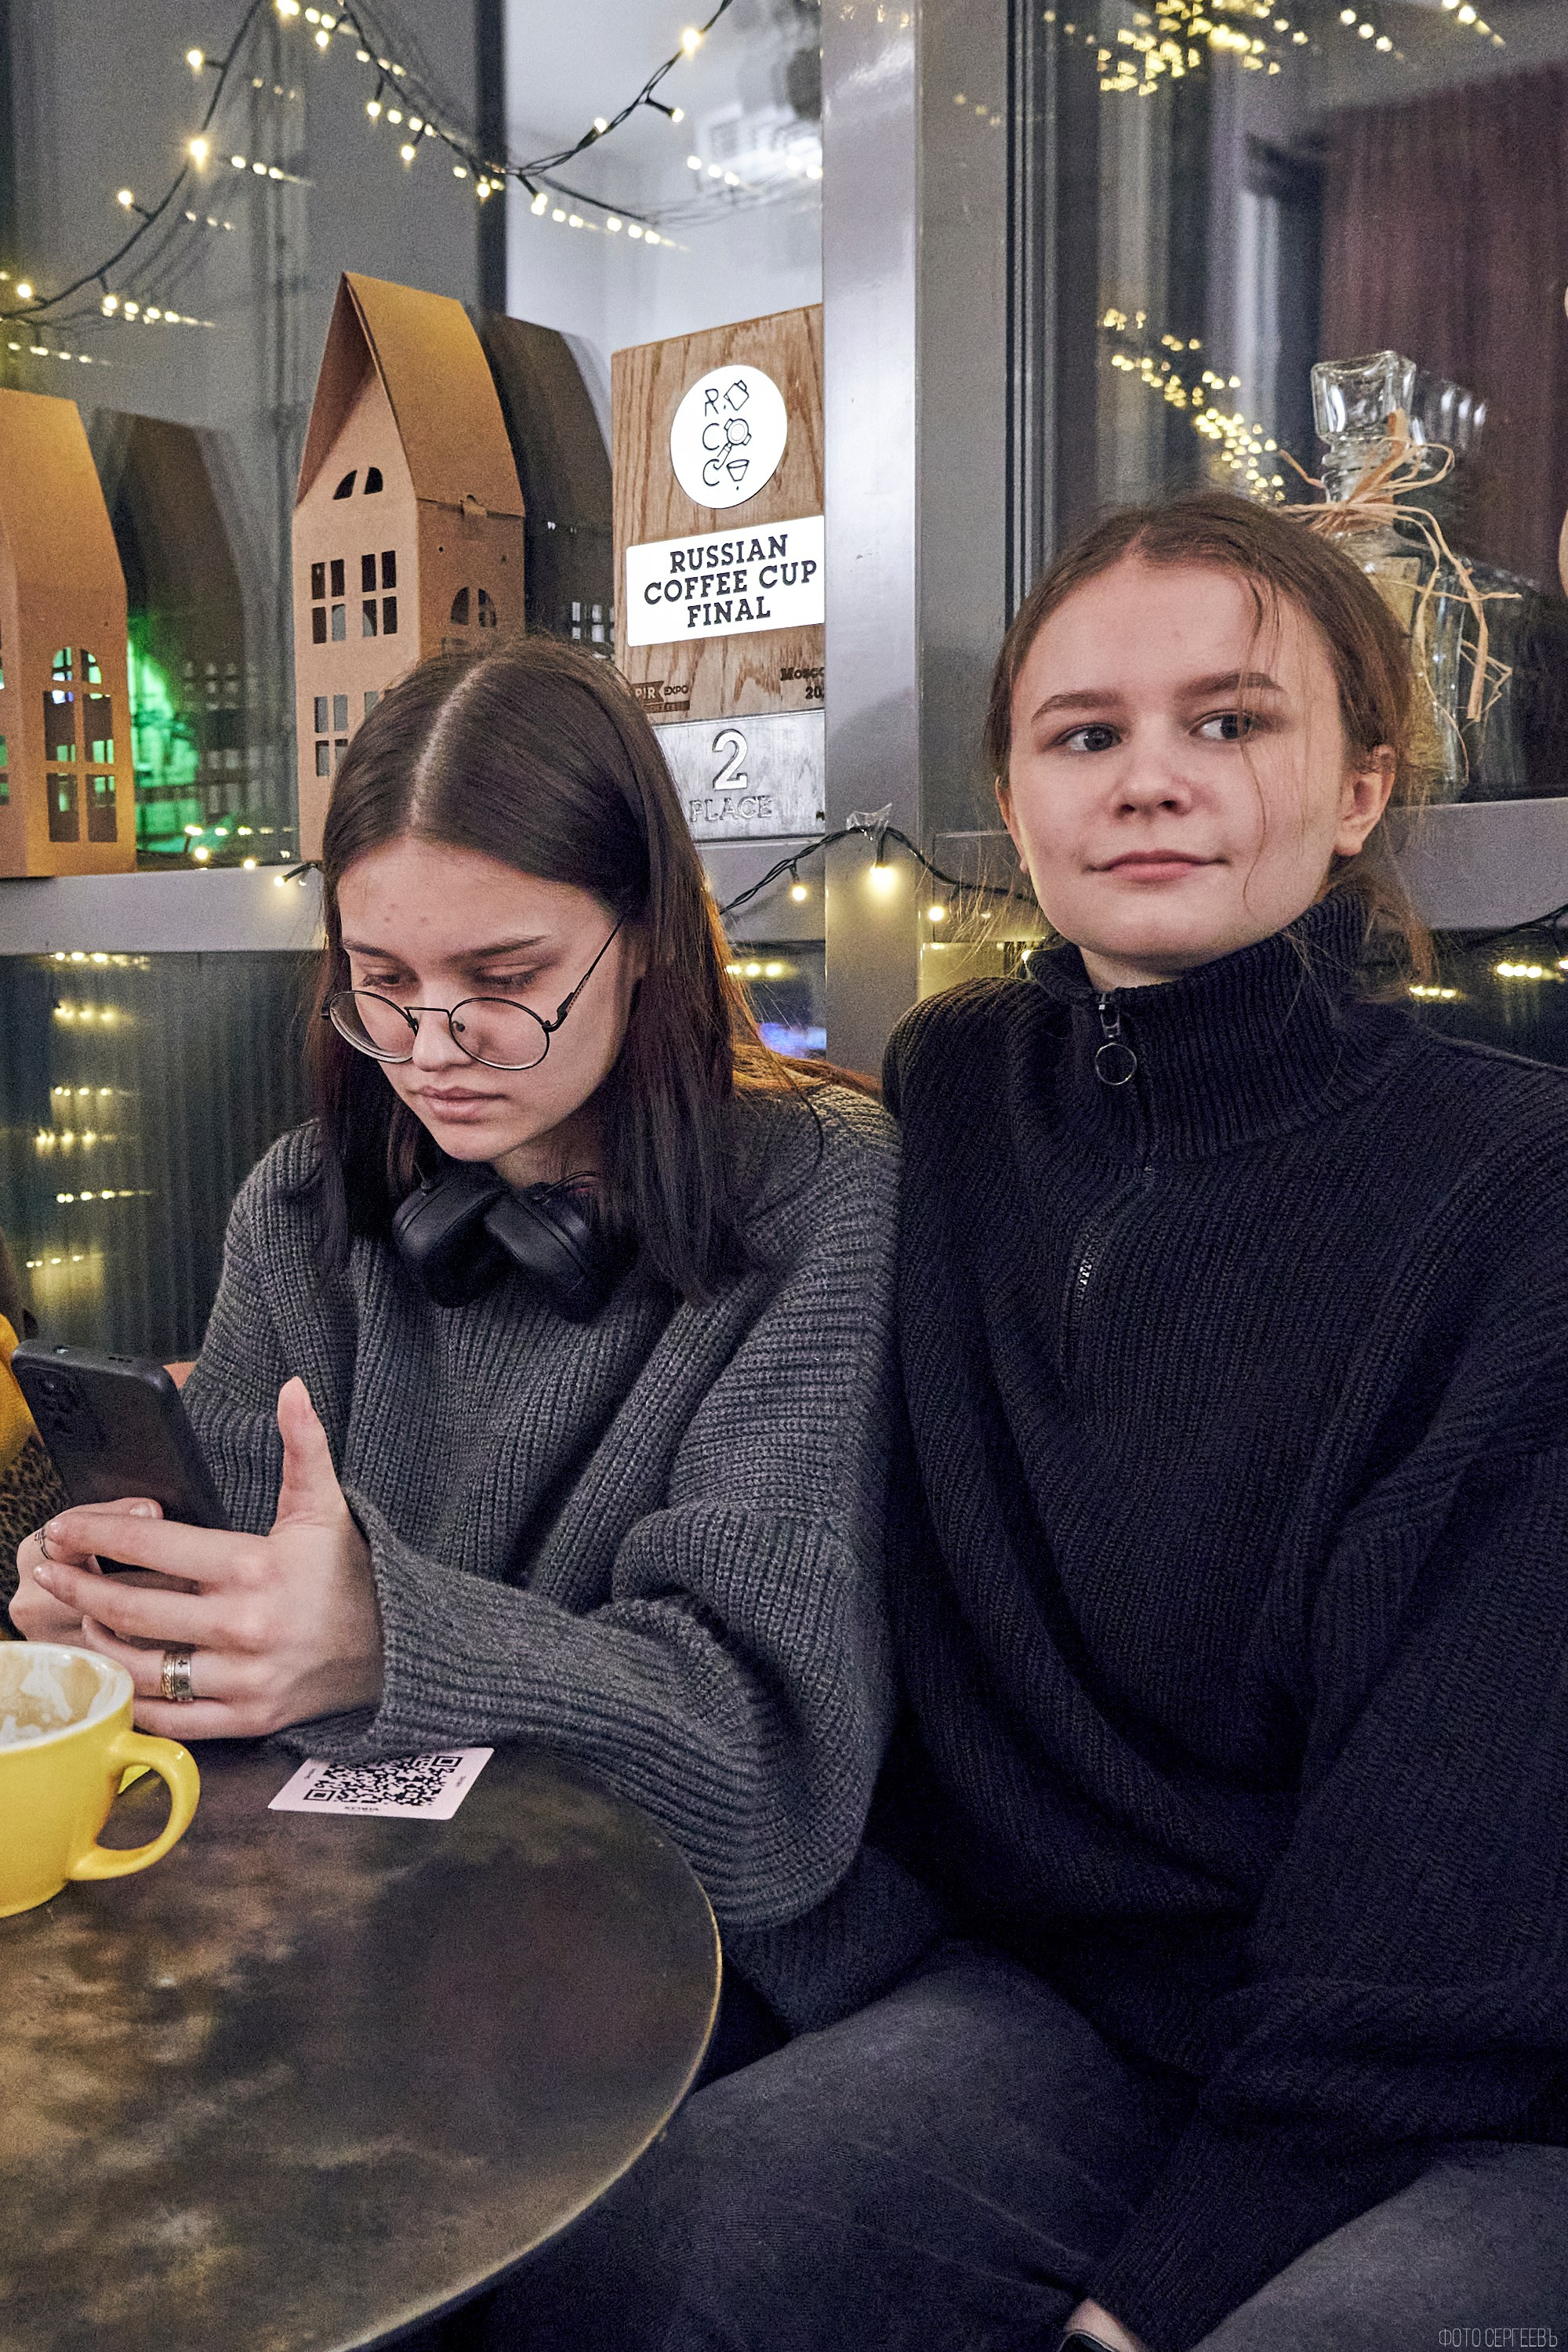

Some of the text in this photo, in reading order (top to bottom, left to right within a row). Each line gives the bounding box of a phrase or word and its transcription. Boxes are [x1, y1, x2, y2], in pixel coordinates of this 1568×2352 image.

[670, 534, 789, 574] RUSSIAN
[644, 560, 818, 604] COFFEE CUP
[687, 596, 771, 628] FINAL
[664, 685, 688, 695] EXPO
[805, 686, 825, 699] 20
[712, 728, 748, 791] 2
[689, 795, 772, 822] PLACE
